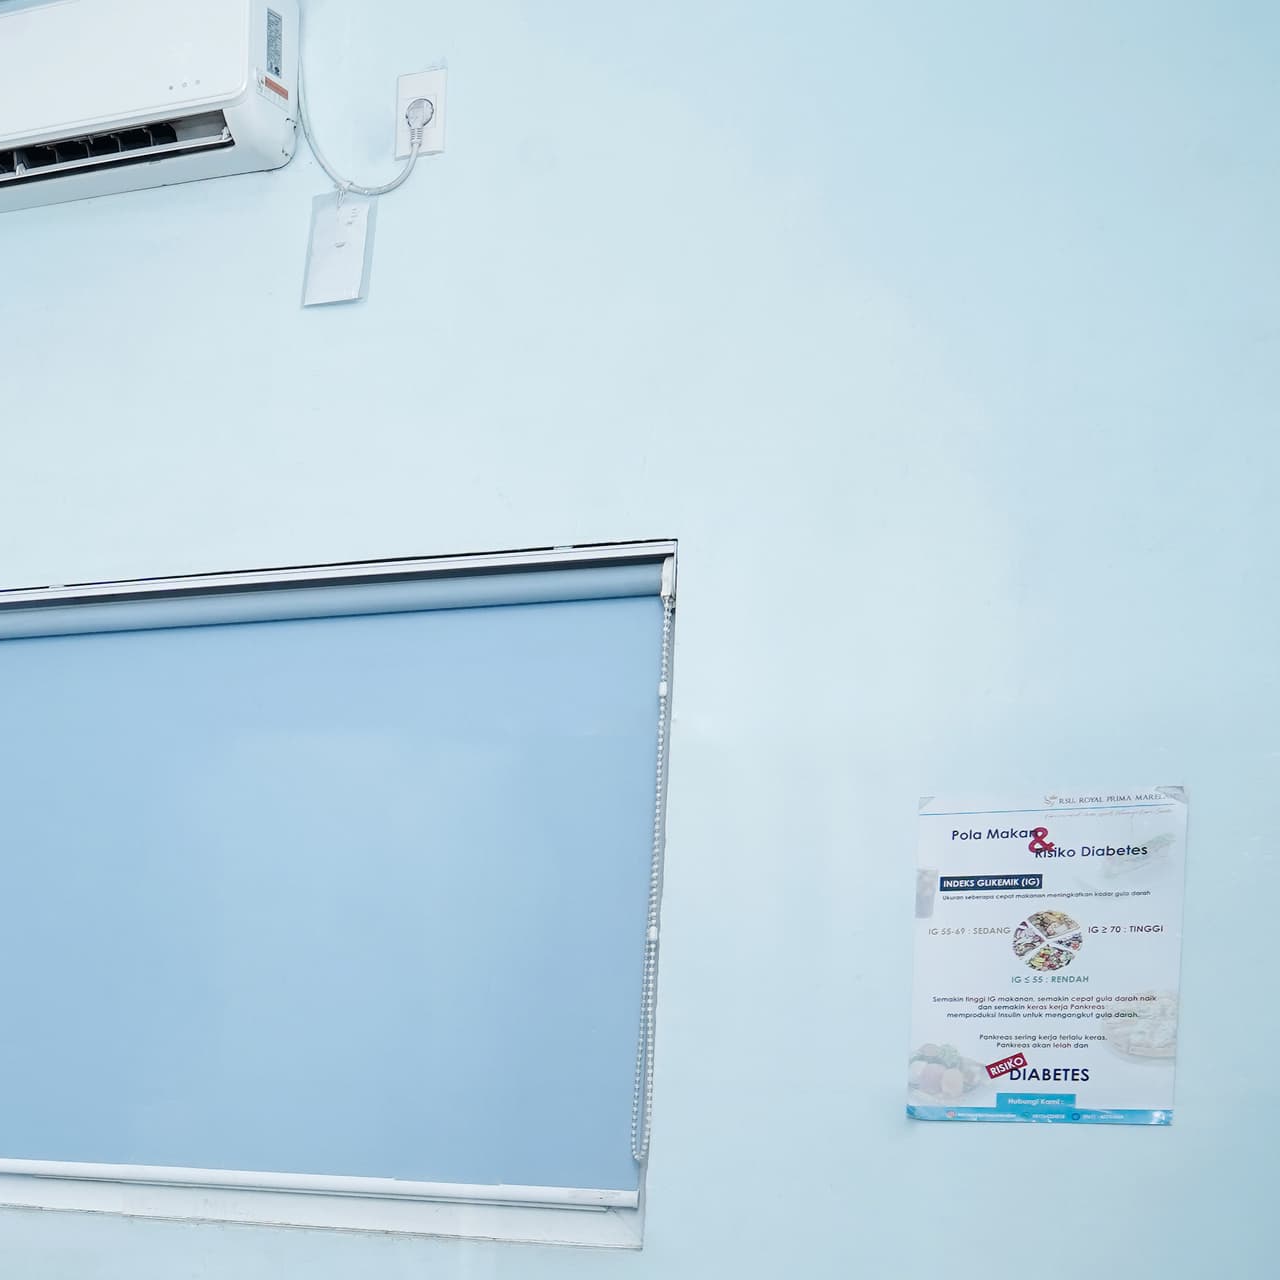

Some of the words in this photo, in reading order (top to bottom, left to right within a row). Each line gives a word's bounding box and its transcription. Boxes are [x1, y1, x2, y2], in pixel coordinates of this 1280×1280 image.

[952, 830, 981, 841] Pola
[1028, 827, 1055, 853] &
[1082, 845, 1148, 857] Diabetes
[944, 880, 974, 888] INDEKS
[1021, 878, 1040, 887] (IG)
[941, 927, 965, 935] 55-69
[1129, 925, 1163, 933] TINGGI
[990, 1056, 1024, 1077] RISIKO
[1010, 1068, 1089, 1082] DIABETES
